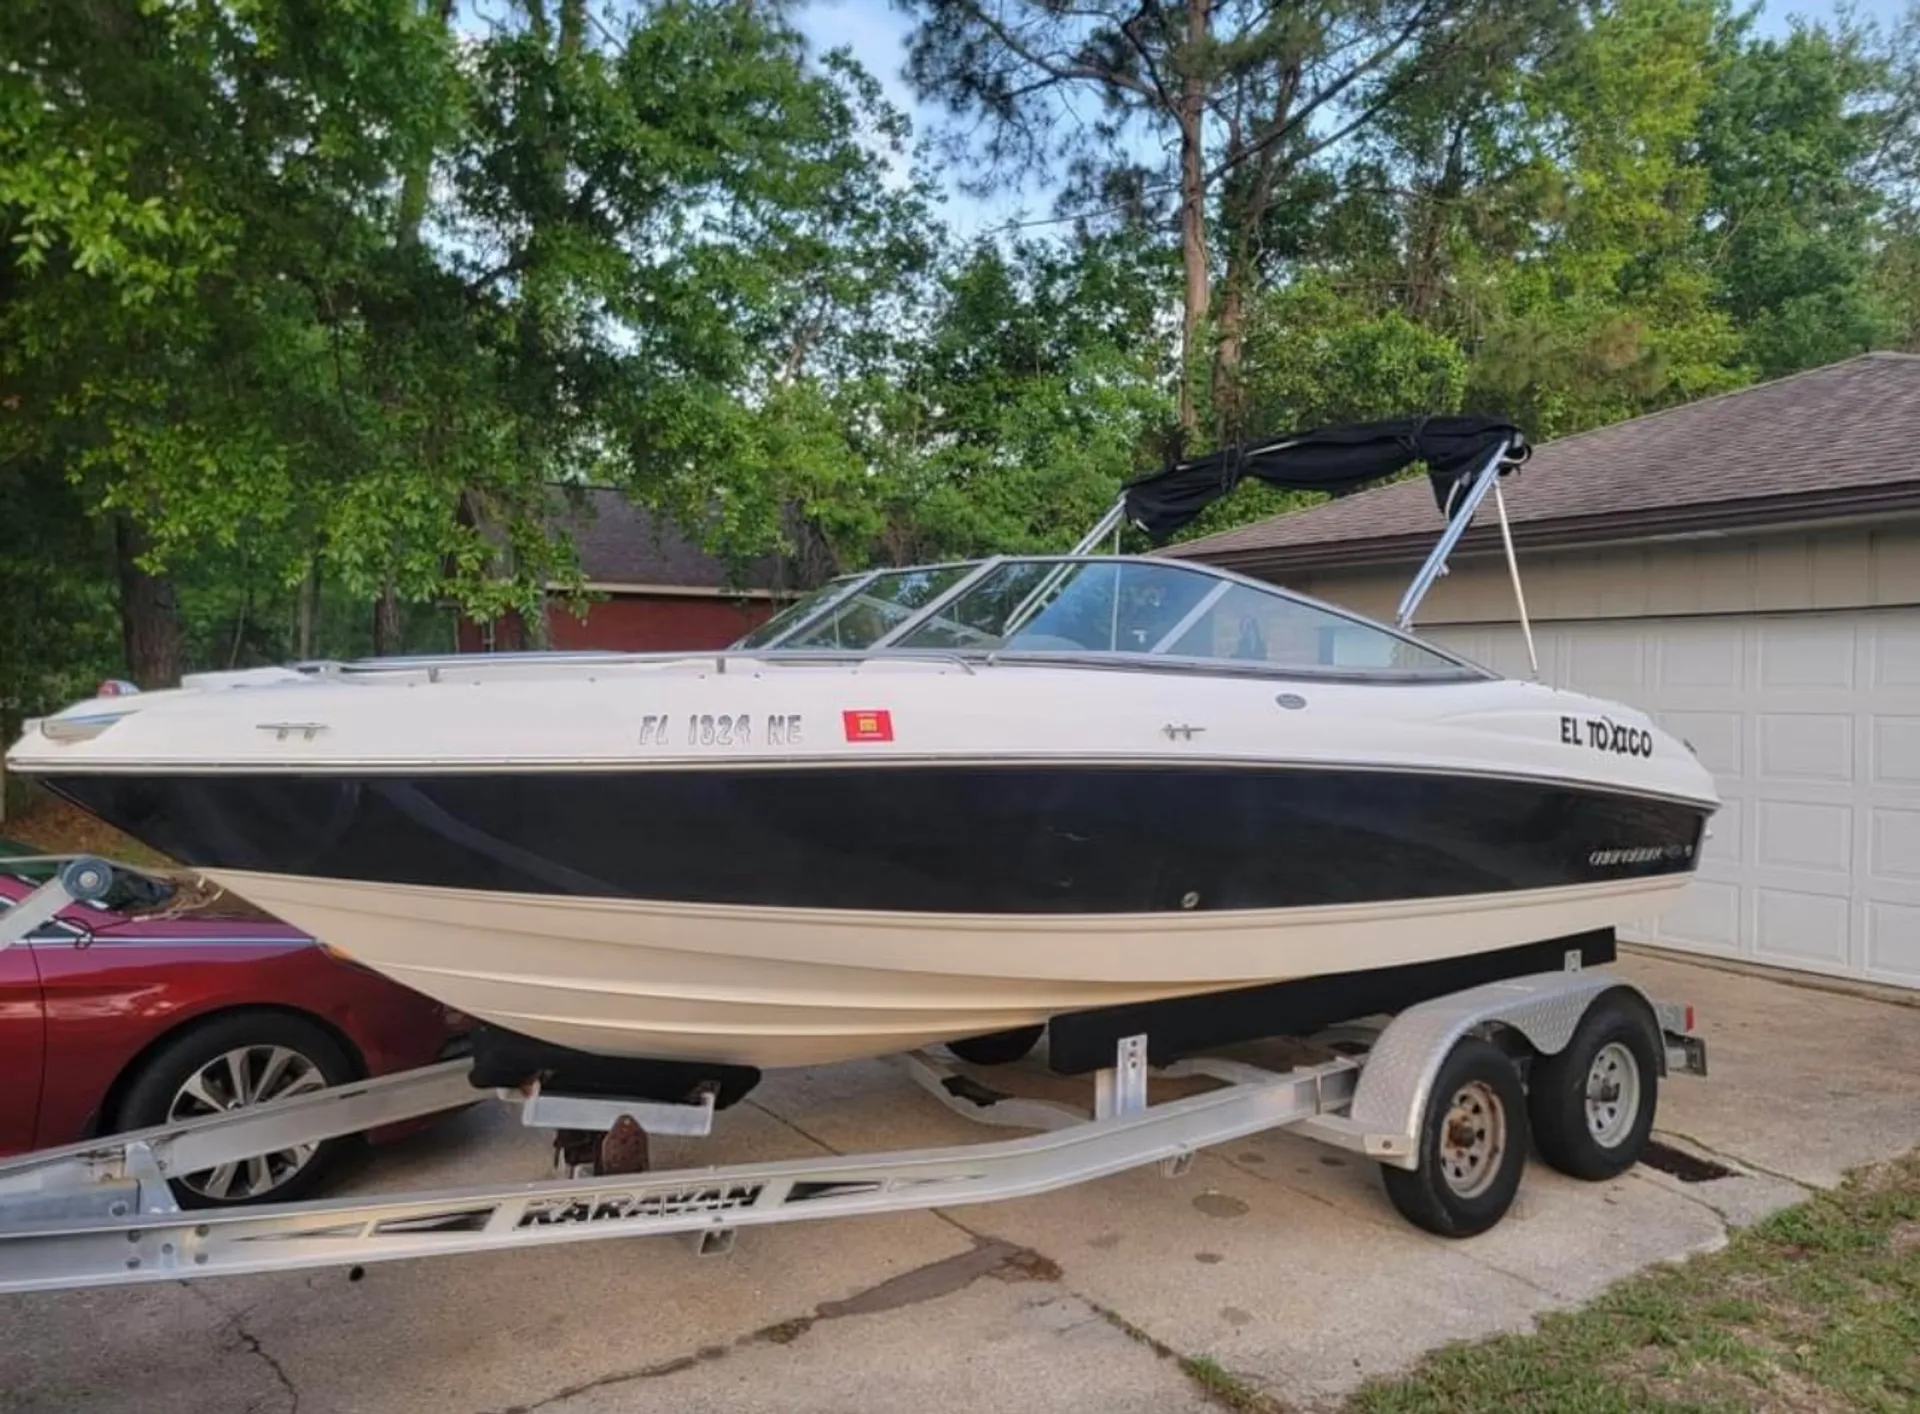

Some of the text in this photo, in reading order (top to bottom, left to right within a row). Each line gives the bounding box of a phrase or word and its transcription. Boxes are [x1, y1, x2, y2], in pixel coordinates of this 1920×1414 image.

[639, 714, 669, 745] FL
[767, 714, 803, 745] NE
[1560, 716, 1583, 746] EL
[517, 1180, 767, 1228] KARAVAN
